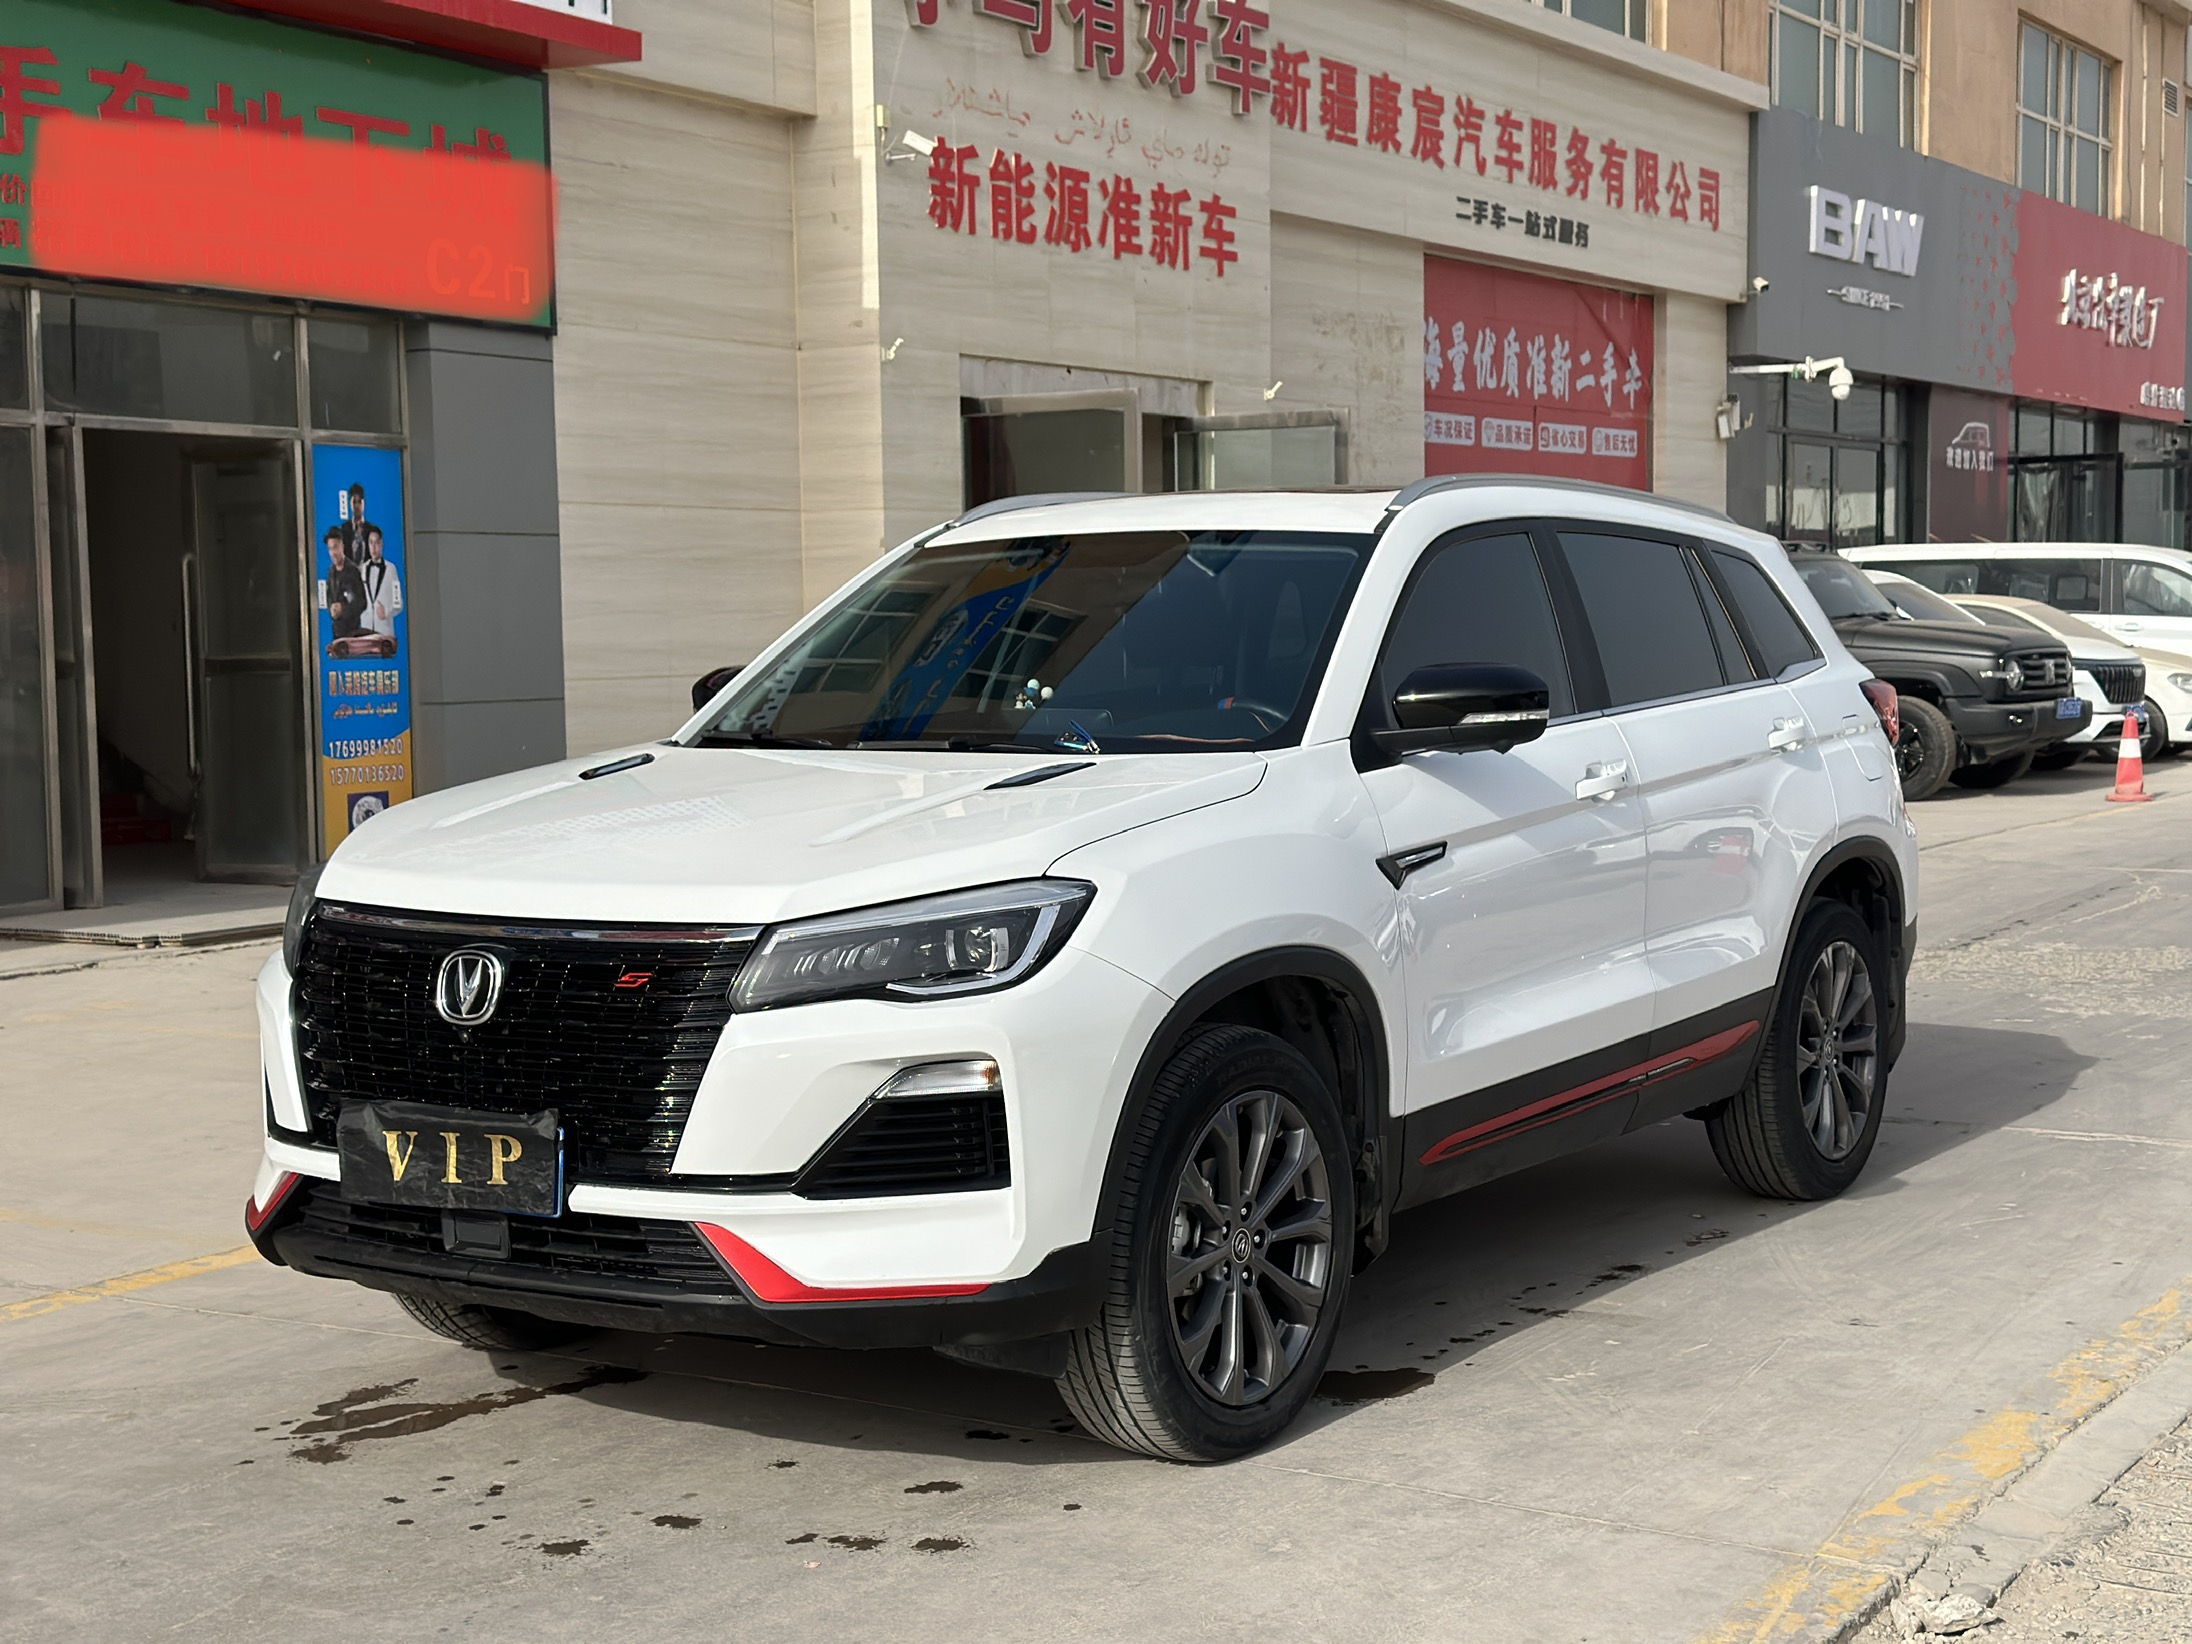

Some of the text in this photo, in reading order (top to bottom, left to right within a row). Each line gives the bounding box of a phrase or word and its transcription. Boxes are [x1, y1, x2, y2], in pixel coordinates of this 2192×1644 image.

[1270, 42, 1721, 232] 新疆康宸汽车服务有限公司
[927, 136, 1239, 277] 新能源准新车
[1809, 185, 1925, 277] BAW
[328, 738, 404, 758] 17699981520
[330, 764, 405, 785] 15770136520
[382, 1130, 523, 1186] VIP
